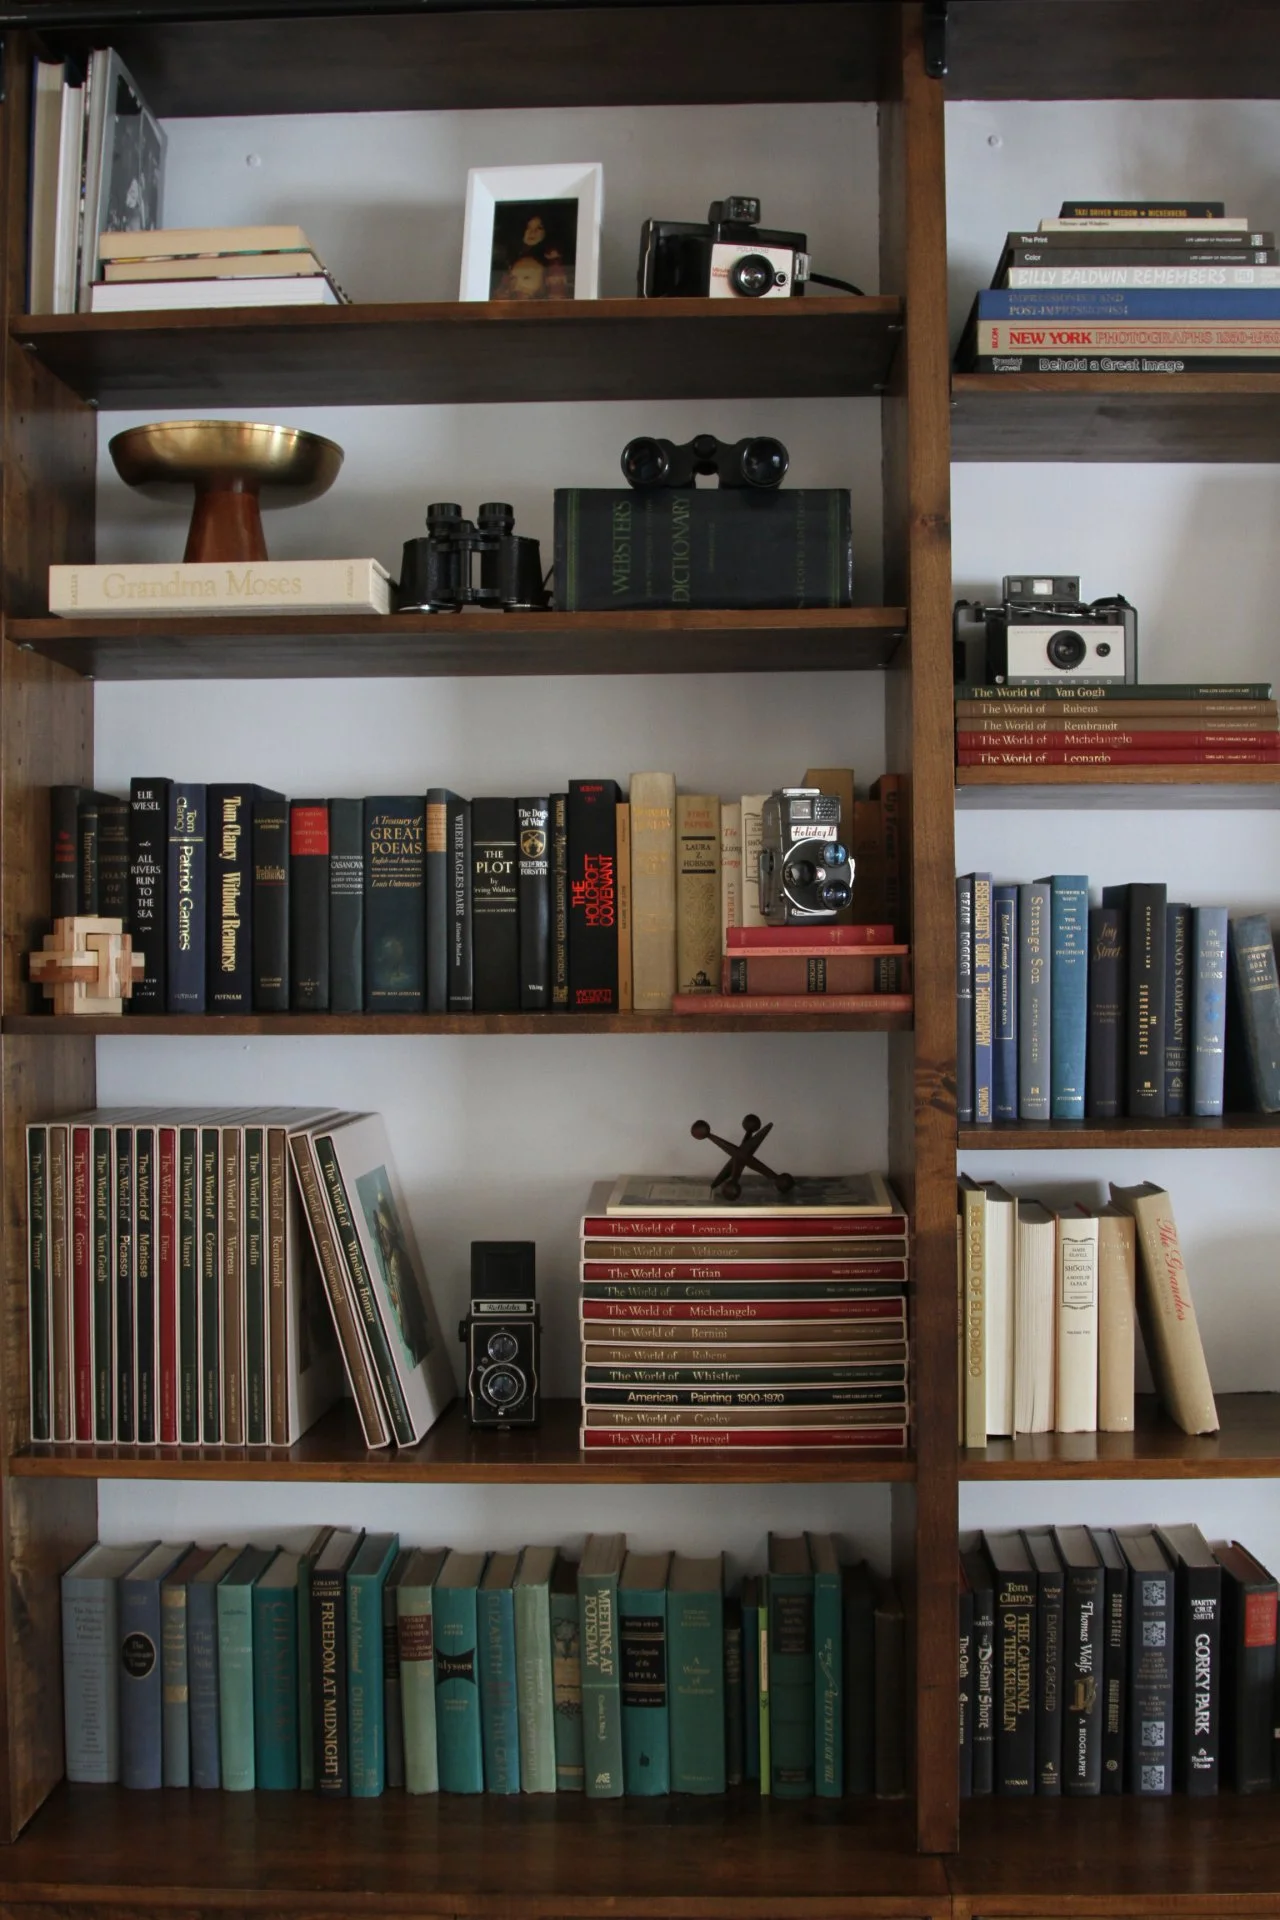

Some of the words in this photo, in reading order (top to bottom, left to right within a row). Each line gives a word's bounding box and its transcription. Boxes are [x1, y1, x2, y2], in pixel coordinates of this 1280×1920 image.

[1020, 236, 1033, 244] The
[1034, 236, 1048, 244] Print
[1017, 268, 1055, 285] BILLY
[1061, 268, 1128, 285] BALDWIN
[1132, 268, 1227, 285] REMEMBERS
[1009, 332, 1045, 344] NEW
[1050, 332, 1092, 344] YORK
[1096, 332, 1212, 344] PHOTOGRAPHS
[1038, 358, 1088, 372] Behold
[1090, 361, 1099, 372] a
[1101, 358, 1140, 372] Great
[1142, 358, 1185, 373] Image
[612, 500, 632, 596] WEBSTER'S
[672, 495, 691, 603] DICTIONARY
[103, 573, 217, 599] Grandma
[225, 570, 303, 596] Moses
[973, 688, 993, 697] The
[997, 688, 1027, 697] World
[1030, 688, 1041, 697] of
[1056, 687, 1074, 698] Van
[1077, 687, 1106, 698] Gogh
[131, 802, 161, 810] WIESEL
[138, 791, 154, 799] ELIE
[175, 797, 188, 833] Clancy
[187, 810, 197, 833] Tom
[223, 796, 242, 822] Tom
[372, 816, 379, 825] A
[381, 815, 411, 826] Treasury
[413, 815, 422, 826] of
[518, 809, 531, 818] The
[687, 810, 710, 819] FIRST
[371, 828, 423, 840] GREAT
[455, 815, 465, 850] WHERE
[684, 821, 714, 829] PAPERS
[219, 824, 242, 861] Clancy
[371, 842, 422, 855] POEMS
[484, 850, 504, 859] THE
[685, 843, 711, 851] LAURA
[131, 866, 161, 874] RIVERS
[137, 855, 154, 863] ALL
[179, 845, 194, 891] Patriot
[455, 852, 465, 888] EAGLES
[476, 861, 513, 875] PLOT
[683, 859, 714, 867] HOBSON
[136, 877, 155, 885] RUN
[139, 888, 152, 896] TO
[490, 878, 498, 886] by
[585, 854, 600, 926] HOLCROFT
[599, 854, 614, 927] COVENANT
[138, 899, 154, 907] THE
[222, 872, 241, 917] Without
[456, 890, 466, 916] DARE
[572, 881, 586, 908] THE
[137, 910, 153, 918] SEA
[960, 891, 971, 925] RIVER
[975, 881, 990, 938] EISENSTAEDT'S
[179, 897, 194, 951] Games
[1028, 896, 1043, 953] Strange
[1099, 922, 1118, 941] Joy
[222, 919, 241, 972] Remorse
[960, 930, 971, 976] LONDON
[976, 944, 990, 968] GUIDE
[1095, 943, 1122, 960] Street
[1175, 916, 1185, 975] PORTNOY'S
[976, 972, 990, 983] TO
[1031, 959, 1044, 984] Son
[976, 987, 990, 1046] PHOTOGRAPHY
[1174, 978, 1184, 1042] COMPLAINT
[978, 1087, 989, 1117] VIKING
[139, 1154, 149, 1173] The
[184, 1154, 193, 1174] The
[204, 1152, 214, 1172] The
[249, 1153, 259, 1173] The
[324, 1161, 337, 1182] The
[140, 1176, 149, 1207] World
[184, 1178, 193, 1207] World
[205, 1175, 214, 1205] World
[250, 1177, 259, 1206] World
[328, 1183, 346, 1214] World
[140, 1210, 149, 1220] of
[184, 1210, 193, 1220] of
[205, 1208, 214, 1218] of
[250, 1210, 259, 1219] of
[338, 1216, 350, 1227] of
[969, 1204, 982, 1226] THE
[140, 1234, 150, 1277] Matisse
[183, 1235, 193, 1266] Manet
[205, 1232, 216, 1277] Cézanne
[250, 1234, 259, 1265] Rodin
[346, 1240, 366, 1284] Winslow
[969, 1230, 982, 1272] GOLD
[608, 1268, 629, 1278] The
[631, 1268, 660, 1278] World
[664, 1268, 676, 1278] of
[690, 1268, 721, 1277] Titian
[969, 1276, 982, 1296] OF
[360, 1287, 375, 1322] Homer
[607, 1306, 627, 1316] The
[629, 1306, 659, 1316] World
[663, 1305, 674, 1315] of
[690, 1306, 756, 1317] Michelangelo
[970, 1300, 982, 1315] EL
[969, 1316, 982, 1377] DORADO
[628, 1392, 678, 1401] American
[691, 1392, 731, 1403] Painting
[737, 1393, 784, 1402] 1900-1970
[1000, 1592, 1034, 1604] Clancy
[1006, 1582, 1028, 1593] Tom
[585, 1595, 599, 1667] POTSDAM
[598, 1589, 613, 1657] MEETING
[1004, 1614, 1016, 1632] OF
[1018, 1614, 1030, 1643] THE
[1080, 1601, 1094, 1642] Thomas
[321, 1602, 336, 1673] FREEDOM
[351, 1626, 363, 1673] Malamud
[960, 1635, 969, 1654] The
[1004, 1635, 1016, 1663] THE
[1046, 1614, 1057, 1662] EMPRESS
[601, 1659, 613, 1677] AT
[960, 1655, 969, 1678] Oath
[979, 1646, 993, 1692] Distant
[1075, 1644, 1093, 1673] Wolfe
[1195, 1633, 1210, 1690] GORKY
[323, 1677, 336, 1695] AT
[1017, 1645, 1030, 1715] CARDINAL
[1046, 1666, 1056, 1712] ORCHID
[979, 1695, 992, 1728] Shore
[1003, 1665, 1016, 1733] KREMLIN
[1195, 1693, 1210, 1735] PARK
[324, 1698, 339, 1776] MIDNIGHT
[1078, 1728, 1086, 1777] BIOGRAPHY
